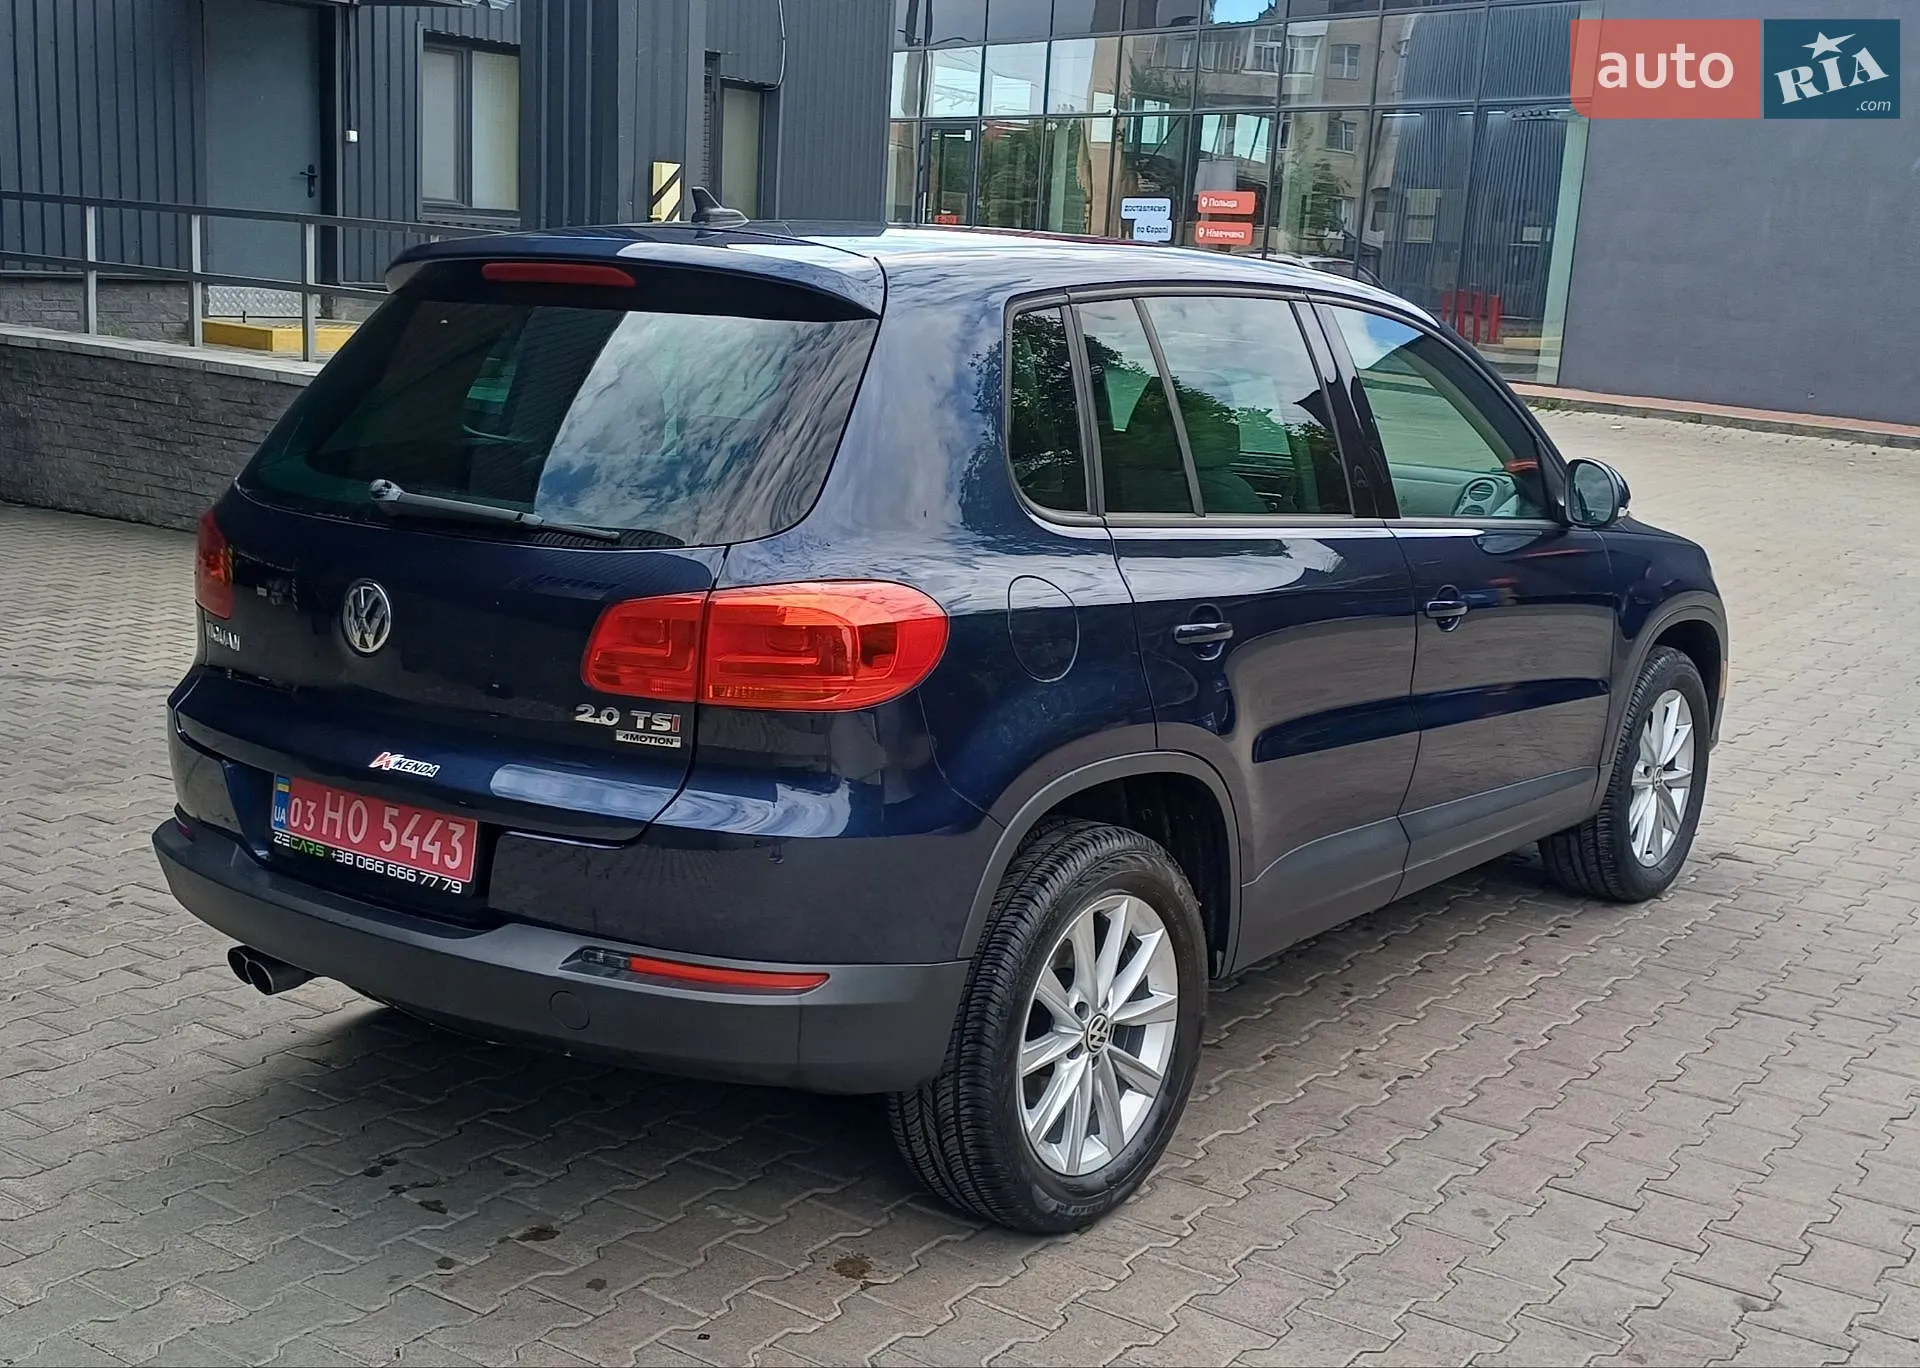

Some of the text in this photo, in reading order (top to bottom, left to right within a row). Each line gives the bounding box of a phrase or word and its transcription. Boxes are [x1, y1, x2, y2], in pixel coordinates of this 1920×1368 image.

[574, 703, 681, 733] 2.0 TSI
[622, 732, 675, 746] 4MOTION
[392, 758, 439, 777] KENDA
[273, 805, 287, 824] UA
[289, 797, 316, 832] 03
[379, 804, 467, 870] 5443
[330, 849, 354, 866] +38
[356, 855, 385, 874] 066
[387, 863, 417, 883] 666
